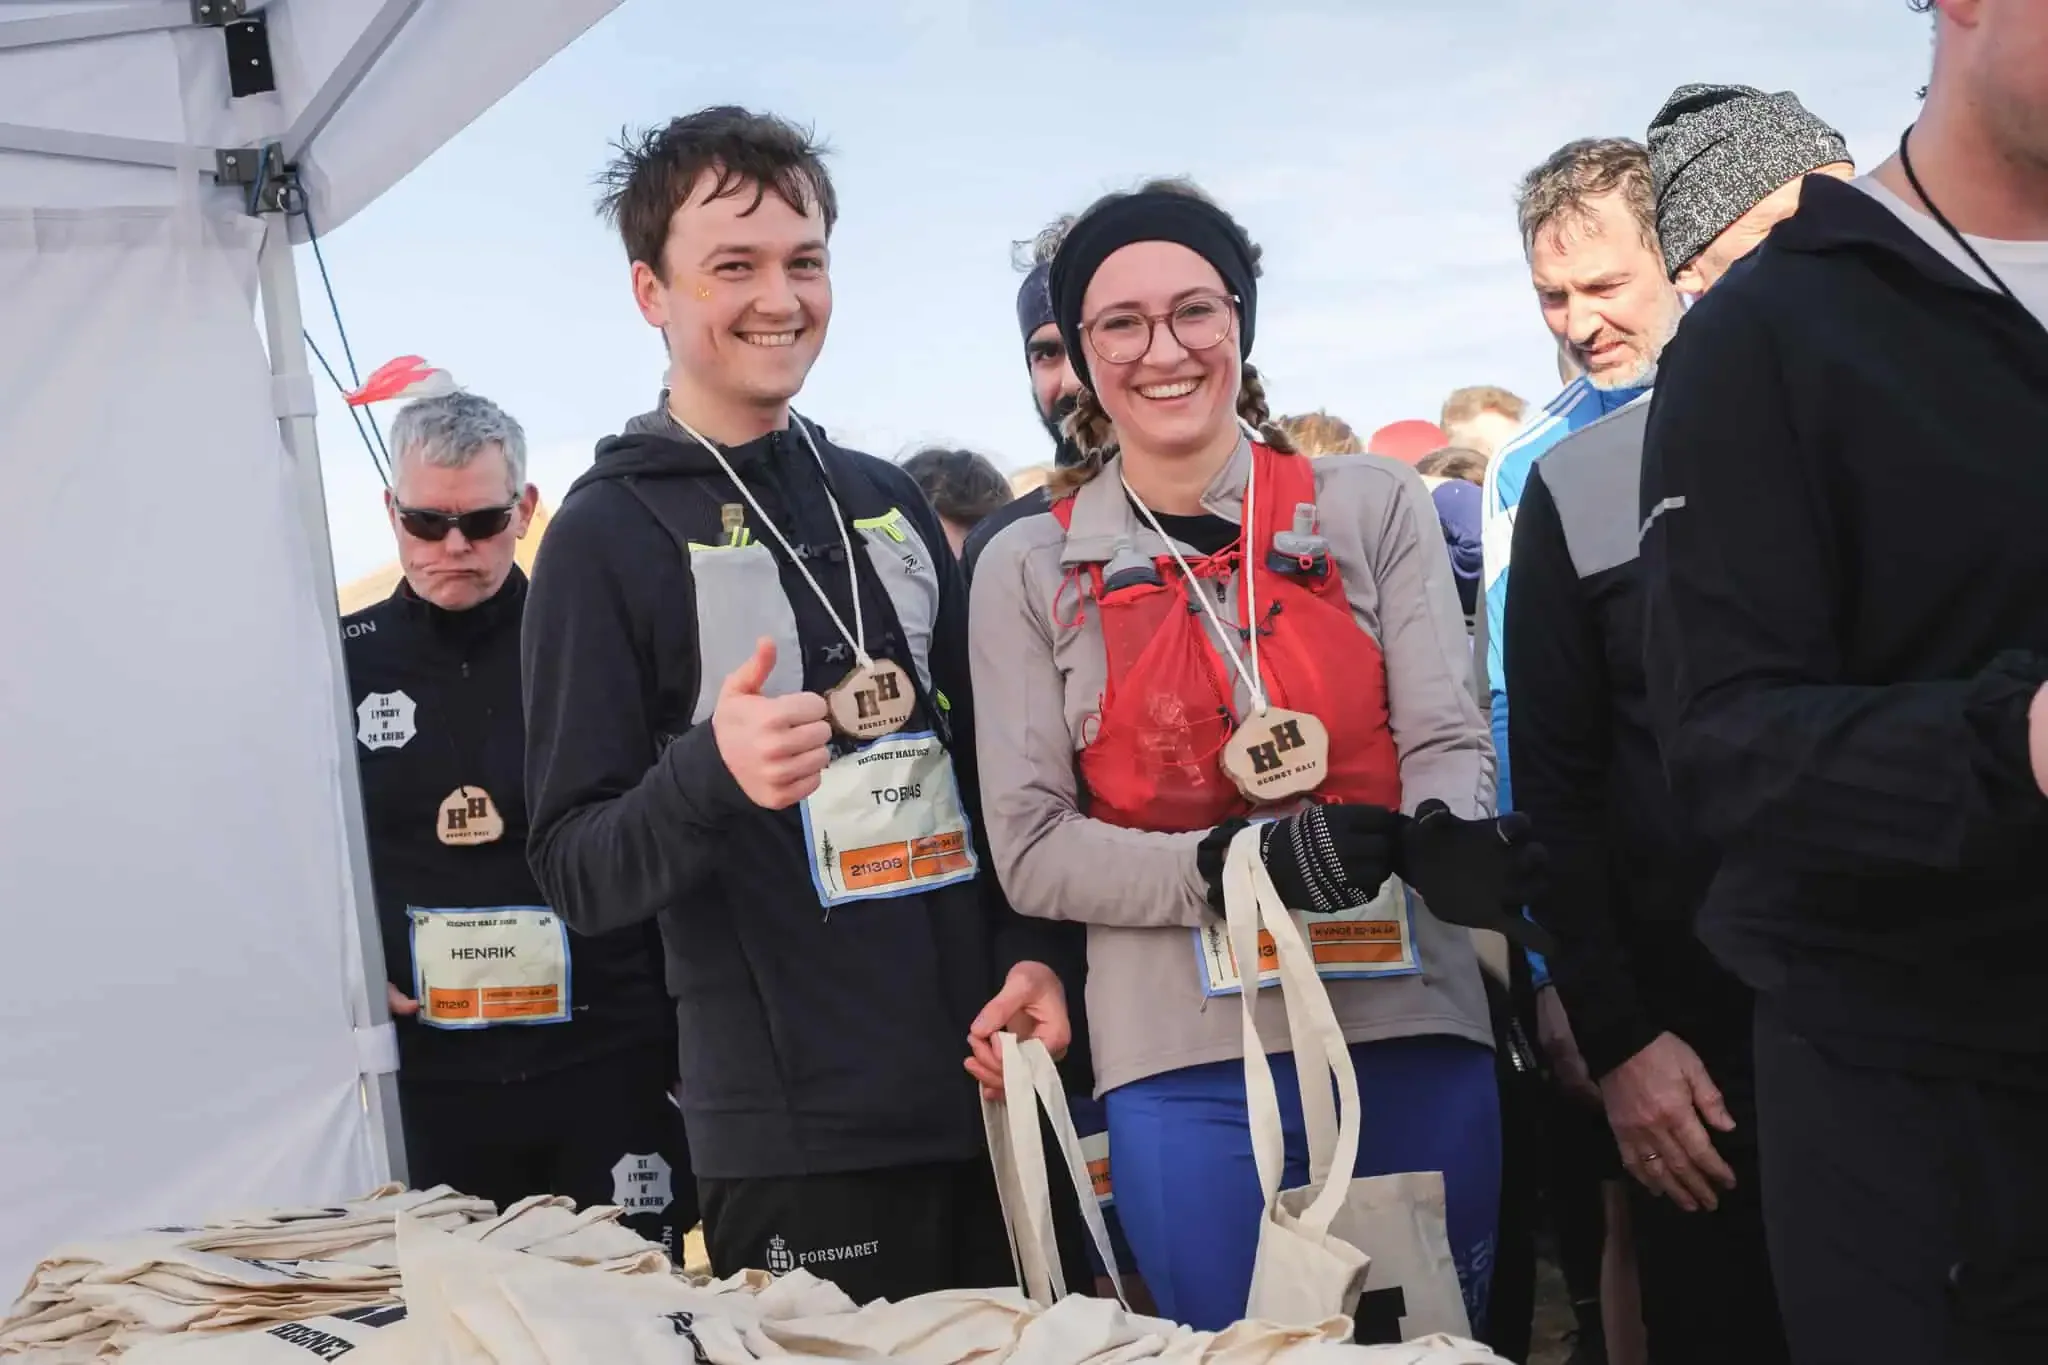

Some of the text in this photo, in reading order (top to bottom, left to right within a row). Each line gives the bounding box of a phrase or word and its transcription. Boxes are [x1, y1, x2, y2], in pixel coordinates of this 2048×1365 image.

[1246, 719, 1306, 775] HH
[857, 751, 894, 766] HEGNET
[1256, 769, 1292, 787] HEGNET
[871, 783, 922, 805] TOBIAS
[450, 946, 517, 960] HENRIK
[628, 1171, 658, 1183] LYNGBY
[799, 1240, 879, 1265] FORSVARET
[266, 1322, 357, 1363] HEGNET
